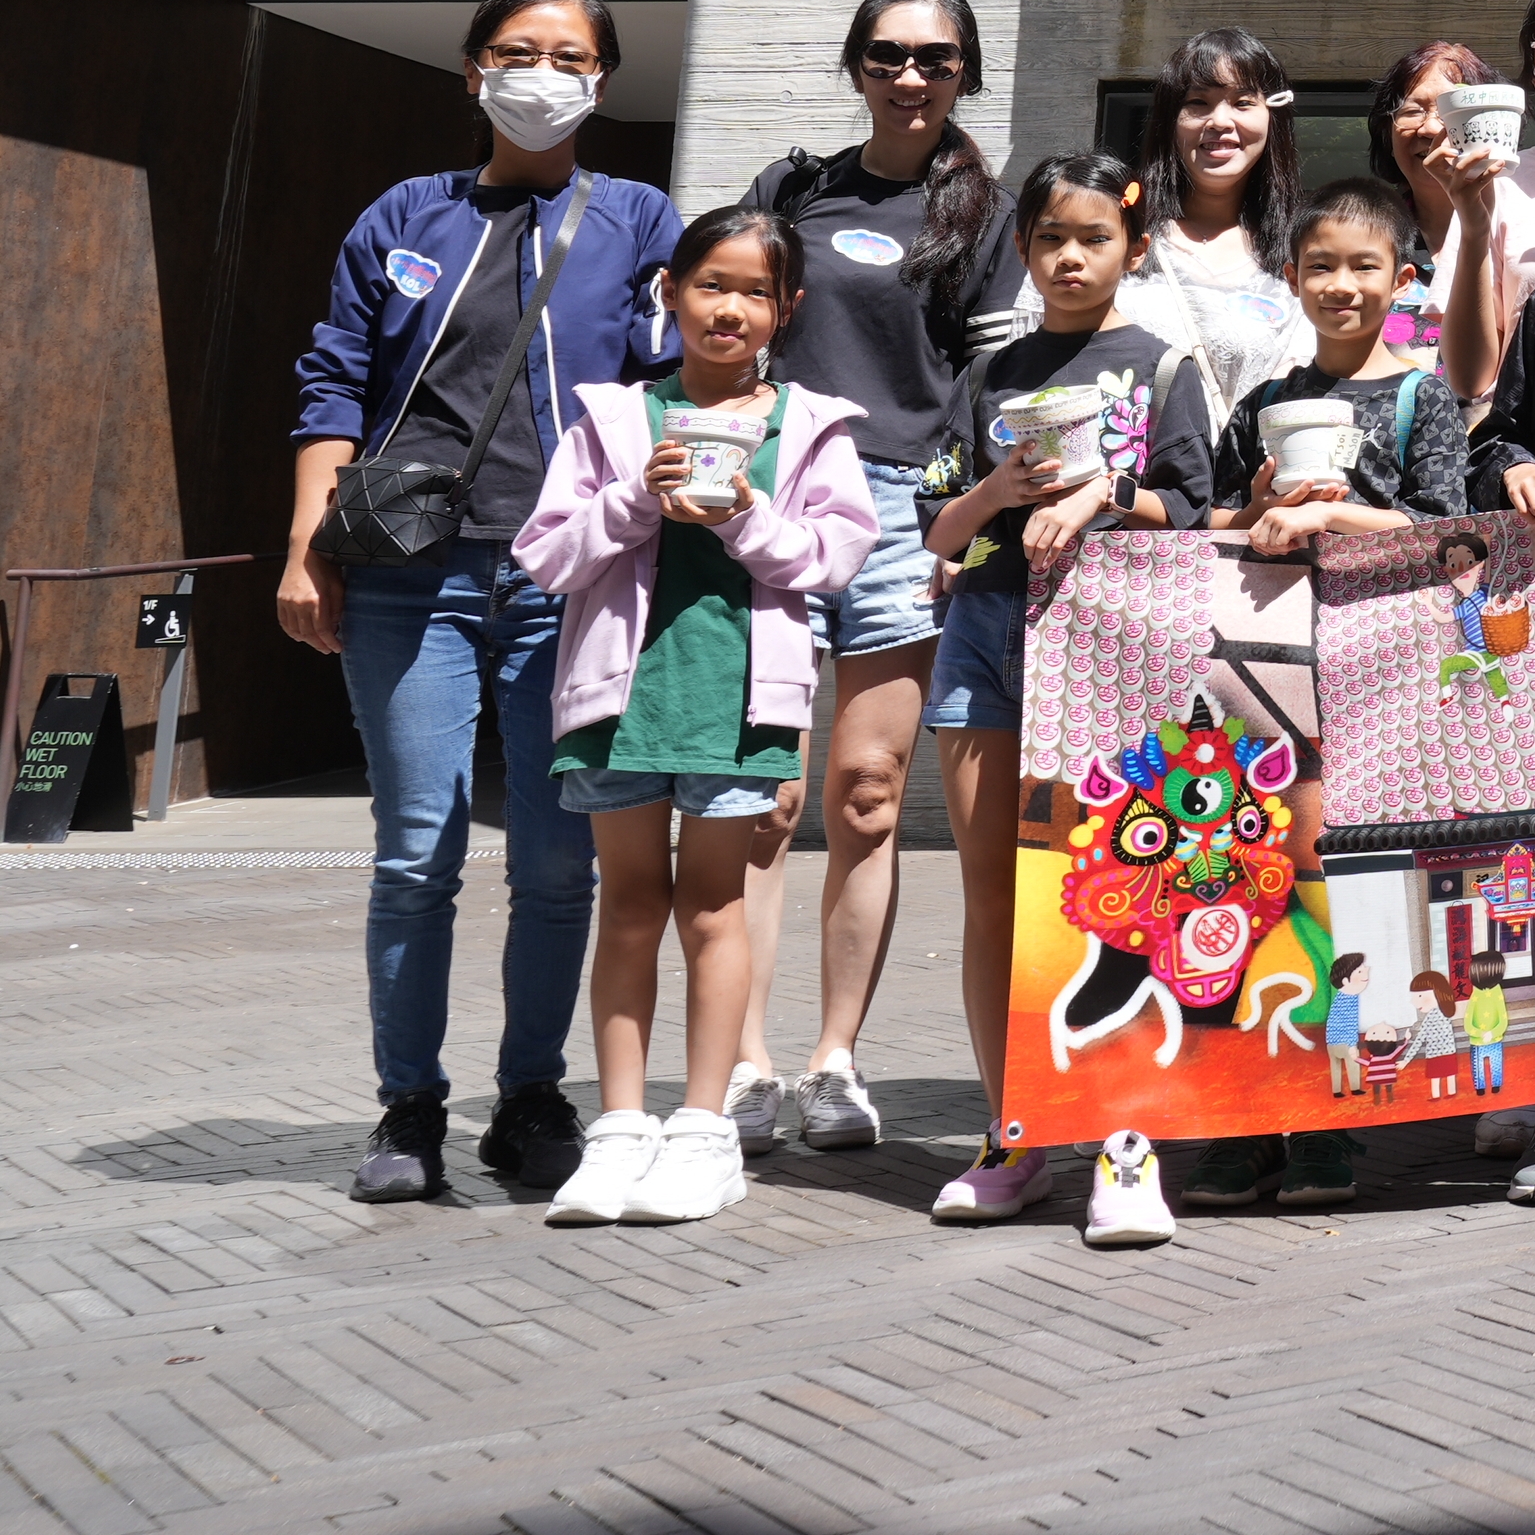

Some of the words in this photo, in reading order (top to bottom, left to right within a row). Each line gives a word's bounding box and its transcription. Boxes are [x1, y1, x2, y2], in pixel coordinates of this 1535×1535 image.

[143, 599, 158, 611] 1/F
[30, 731, 94, 746] CAUTION
[25, 748, 58, 762] WET
[19, 764, 67, 779] FLOOR
[14, 781, 53, 793] 小心地滑
